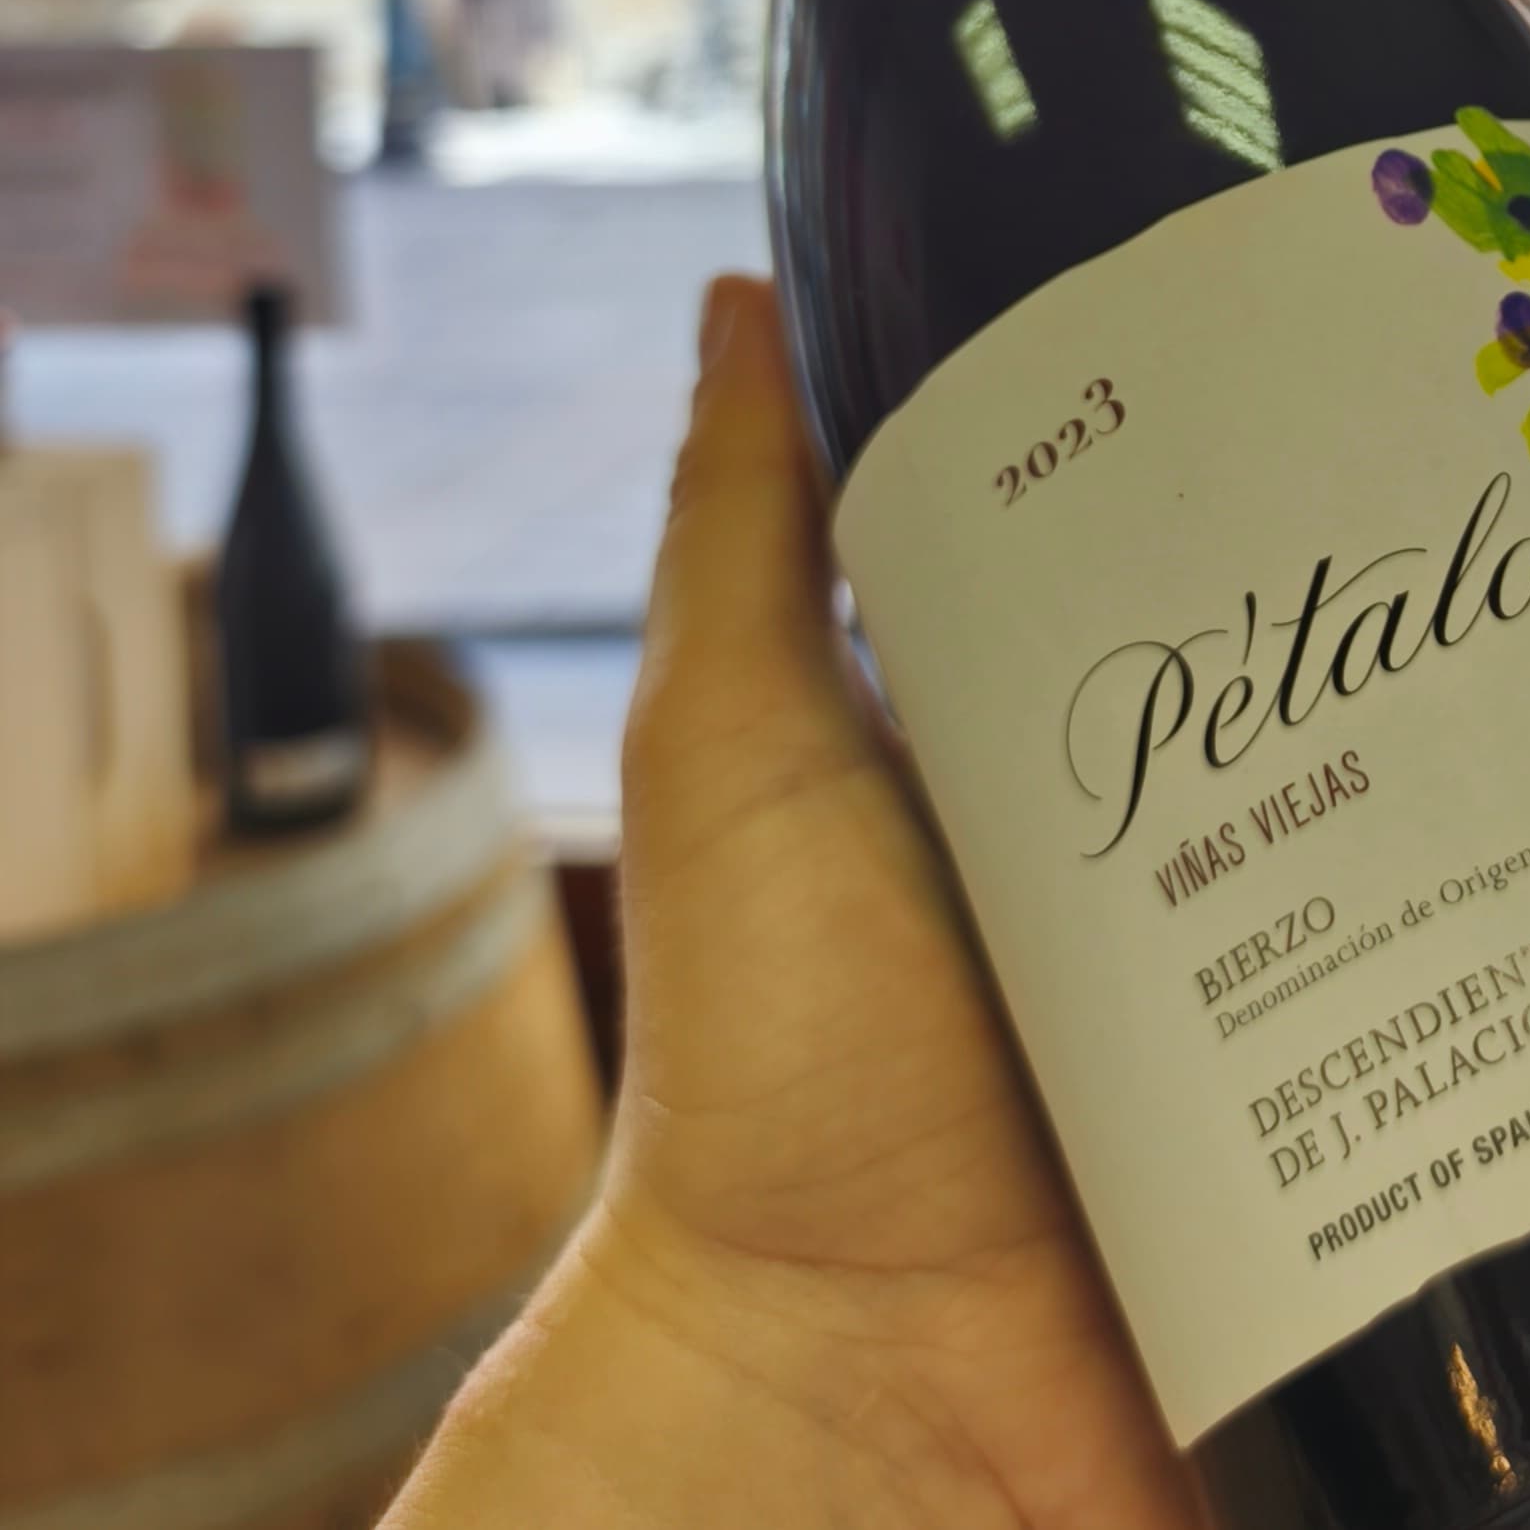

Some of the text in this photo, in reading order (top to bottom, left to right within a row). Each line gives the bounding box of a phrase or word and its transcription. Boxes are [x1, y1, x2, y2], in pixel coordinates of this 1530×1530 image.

[995, 377, 1126, 507] 2023
[1155, 750, 1370, 907] VIÑAS VIEJAS
[1195, 896, 1335, 1005] BIERZO
[1215, 921, 1394, 1039] Denominación
[1401, 900, 1434, 927] de
[1269, 1129, 1326, 1188] DE
[1330, 1112, 1361, 1158] J.
[1308, 1172, 1422, 1261] PRODUCT
[1430, 1148, 1464, 1188] OF
